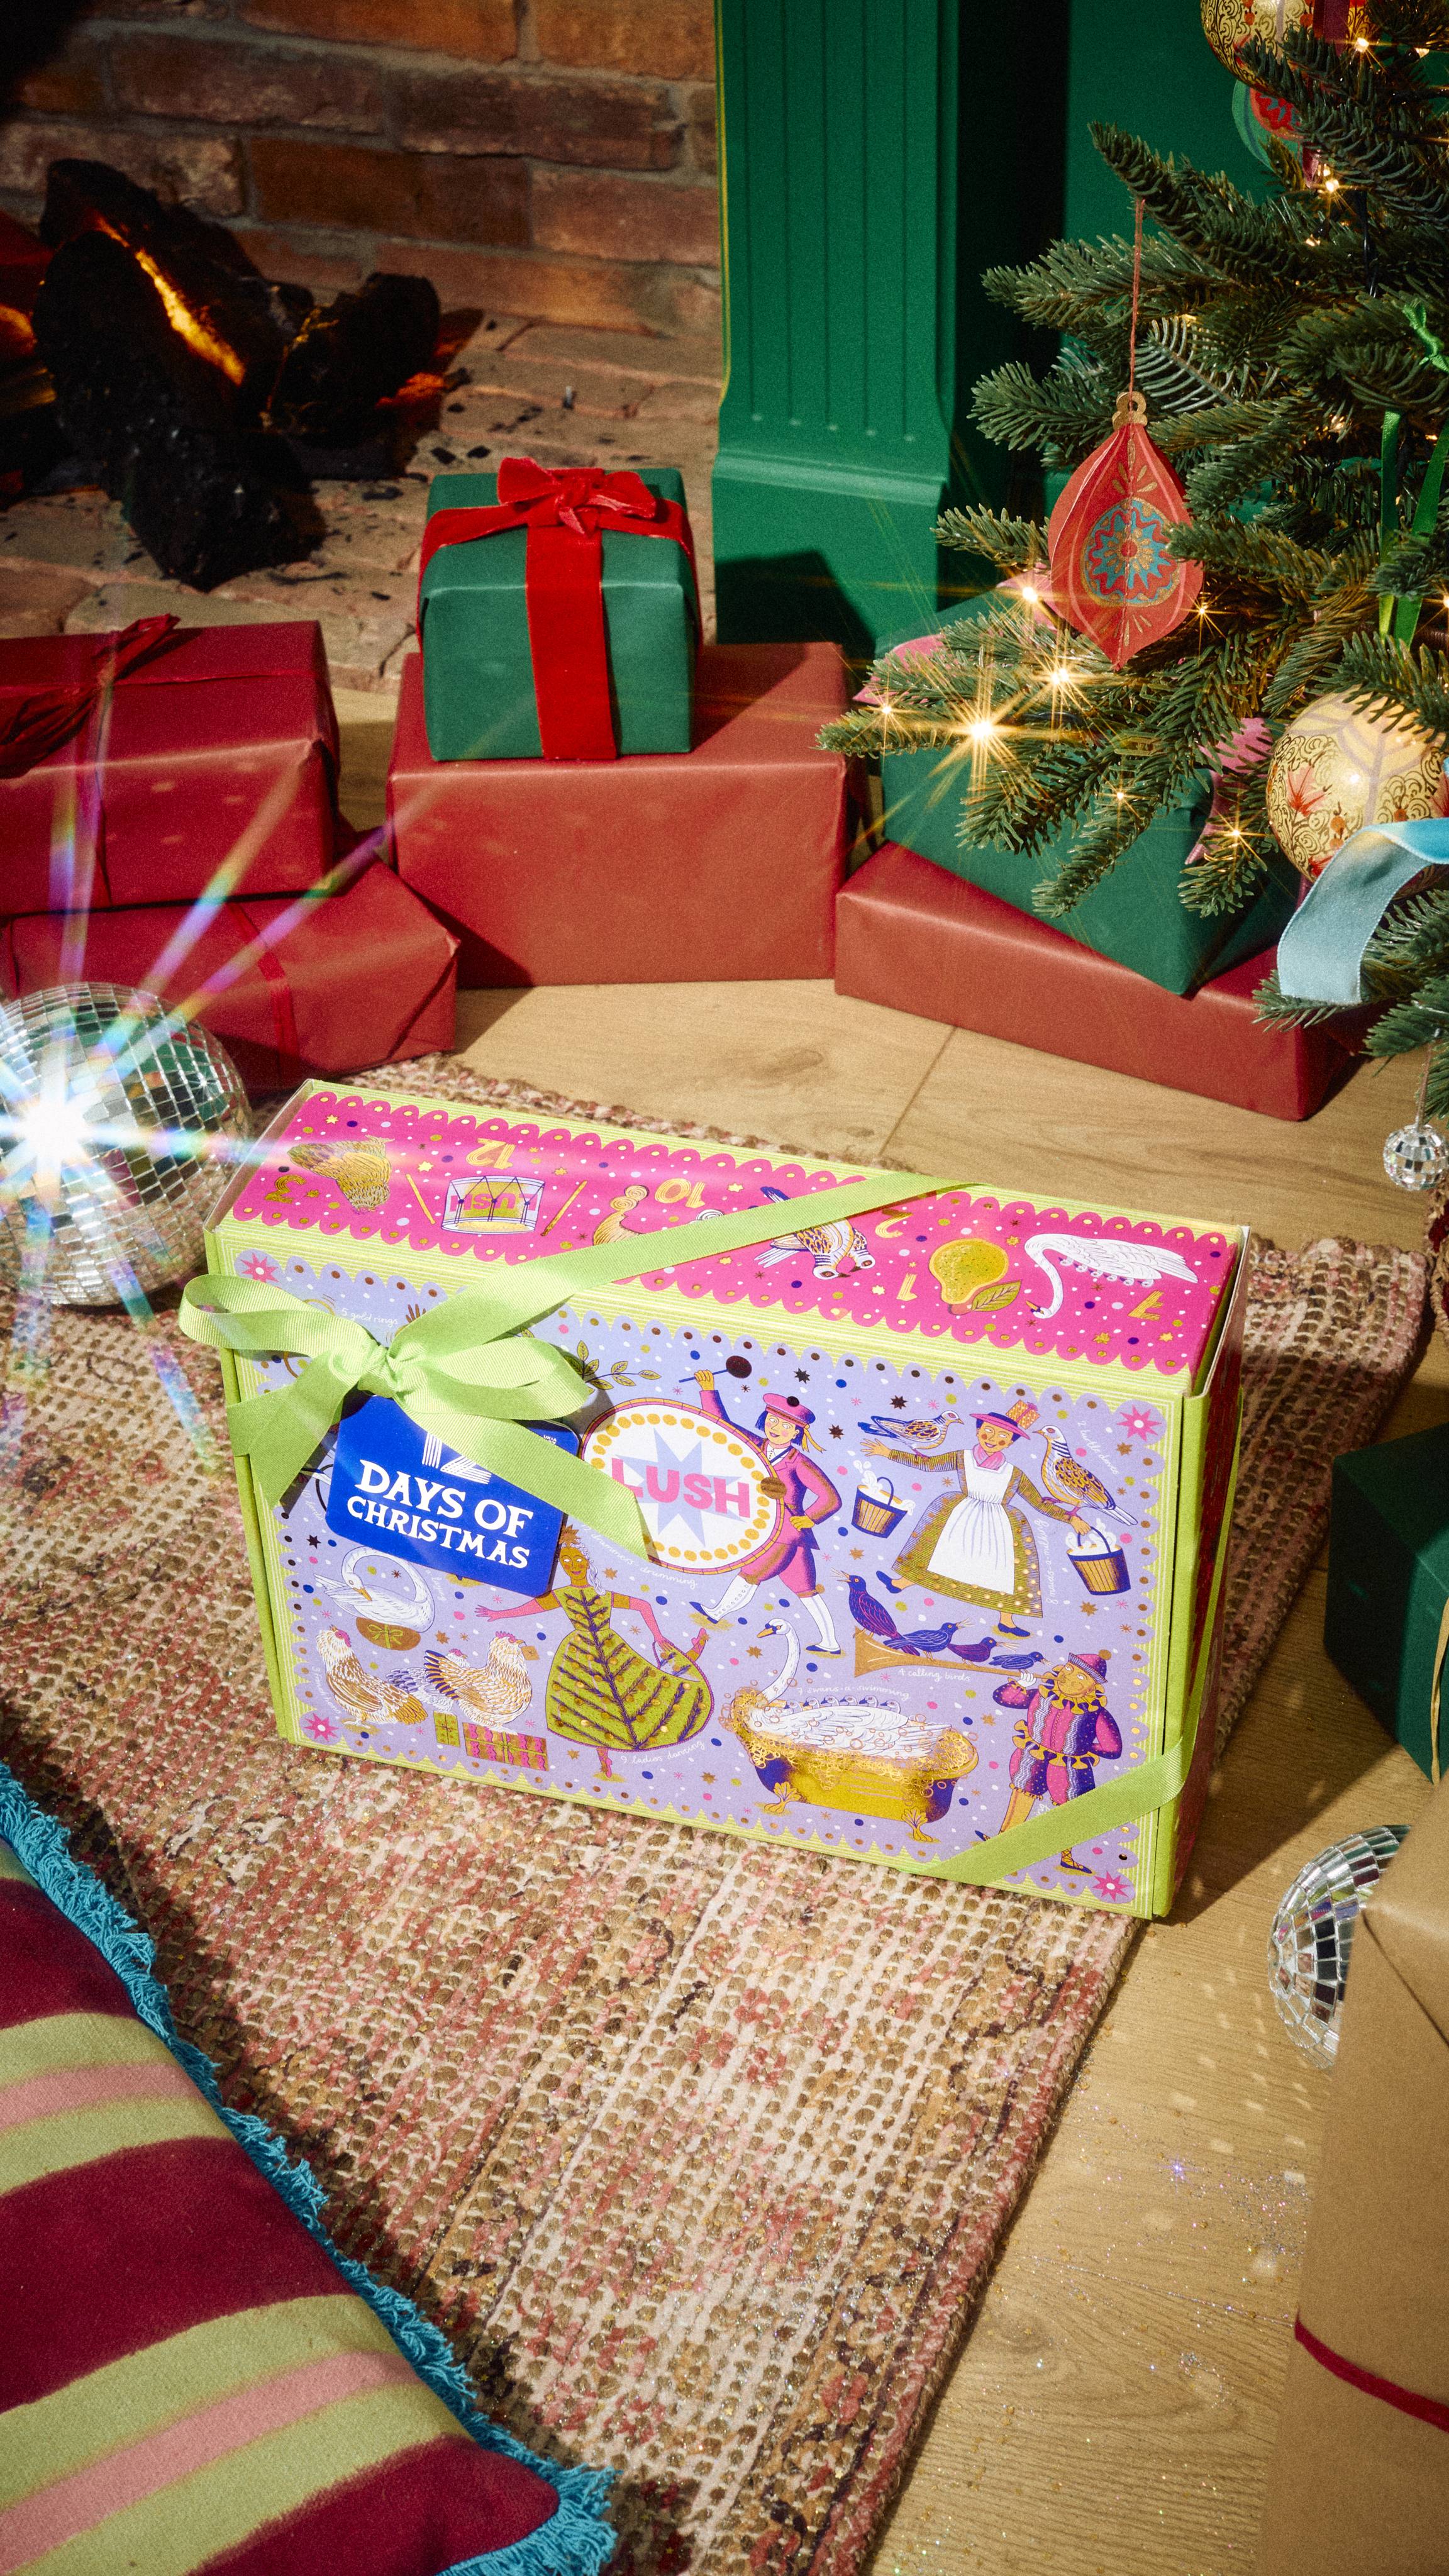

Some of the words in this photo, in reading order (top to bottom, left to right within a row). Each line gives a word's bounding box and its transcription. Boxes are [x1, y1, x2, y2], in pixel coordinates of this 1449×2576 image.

[466, 1138, 517, 1170] 12
[264, 1174, 307, 1204] 3
[450, 1192, 540, 1212] LUSH
[654, 1177, 706, 1209] 10
[875, 1208, 914, 1239] 2
[341, 1307, 349, 1316] 5
[350, 1312, 373, 1323] gold
[373, 1316, 399, 1328] rings
[1097, 1454, 1119, 1475] doves
[354, 1458, 467, 1519] DAYS
[474, 1499, 534, 1538] OF
[611, 1457, 751, 1518] LUSH
[347, 1496, 530, 1568] CHRISTMAS
[898, 1667, 906, 1677] 4
[908, 1667, 943, 1683] calling
[945, 1671, 972, 1682] birds
[796, 1687, 804, 1696] 7
[620, 1755, 628, 1764] 9
[630, 1754, 663, 1765] ladies
[667, 1740, 706, 1760] dancing
